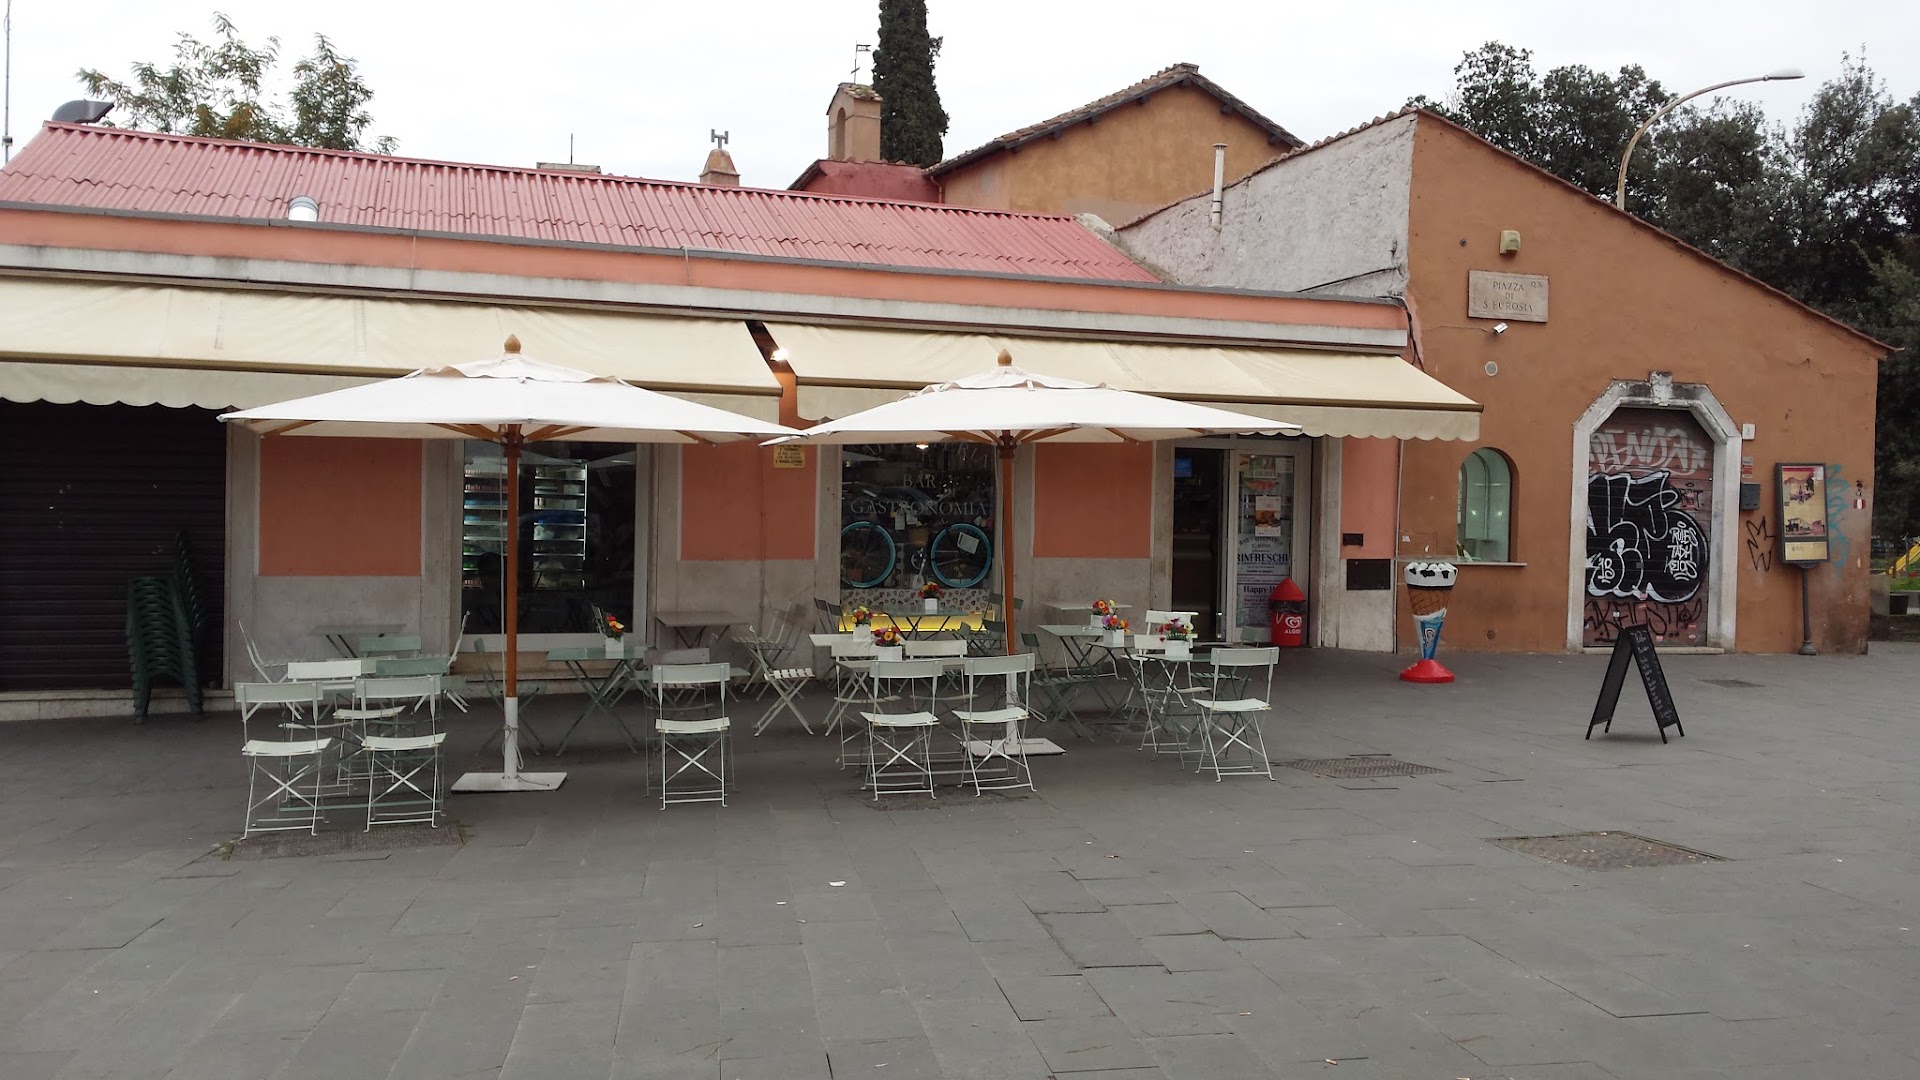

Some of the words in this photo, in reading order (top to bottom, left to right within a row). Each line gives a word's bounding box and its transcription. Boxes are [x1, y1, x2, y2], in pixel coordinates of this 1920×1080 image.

[1493, 282, 1524, 291] PIAZZA
[1493, 301, 1533, 311] EUROSIA
[903, 472, 937, 489] BAR
[850, 498, 987, 516] GASTRONOMIA
[1244, 585, 1267, 594] Happy
